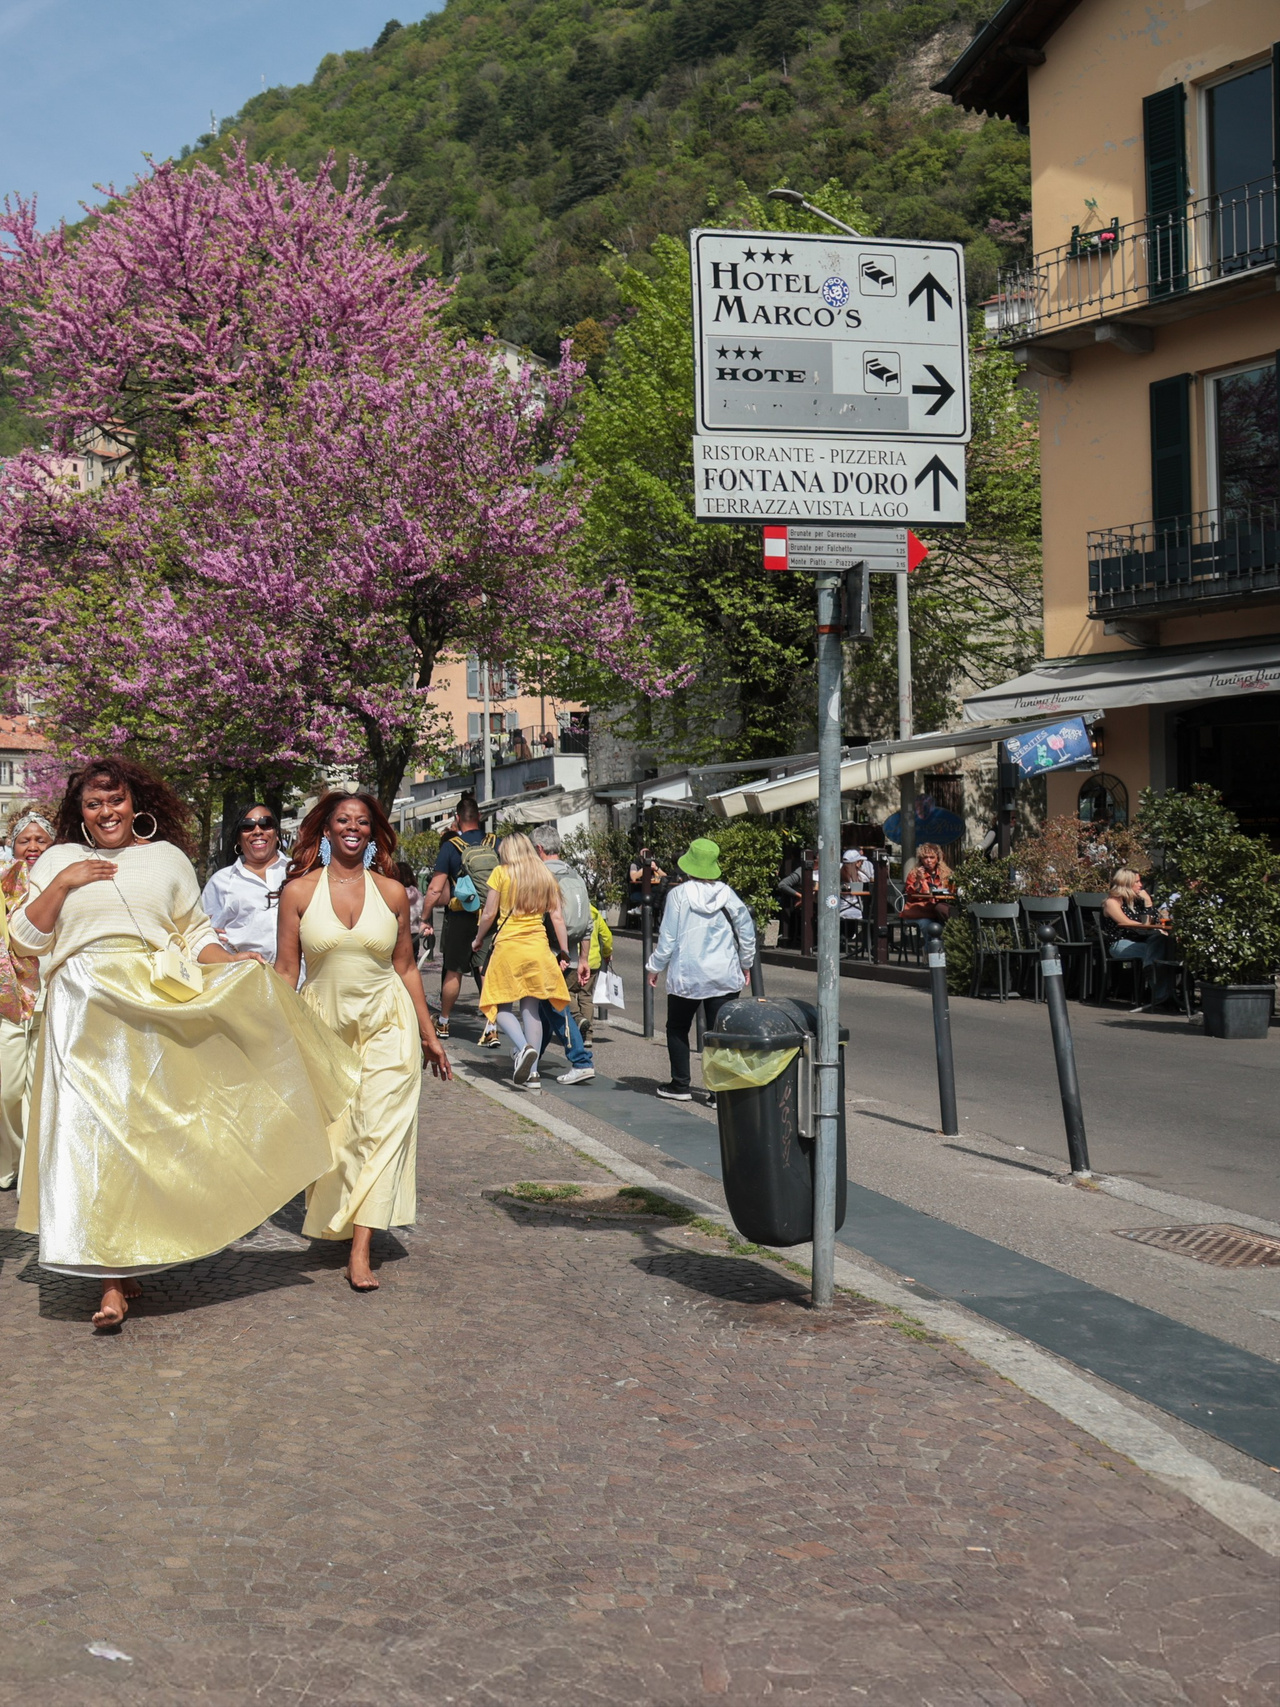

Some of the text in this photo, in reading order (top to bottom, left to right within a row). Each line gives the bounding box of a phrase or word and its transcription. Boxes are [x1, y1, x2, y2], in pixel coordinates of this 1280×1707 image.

[710, 262, 820, 294] HOTEL
[712, 294, 862, 329] MARCO'S
[715, 367, 806, 383] HOTE
[702, 445, 815, 463] RISTORANTE
[830, 449, 907, 466] PIZZERIA
[703, 468, 908, 496] FONTANA D'ORO
[703, 498, 909, 518] TERRAZZA VISTA LAGO
[790, 529, 812, 537] Brunate
[790, 543, 812, 551] Brunate
[1255, 668, 1280, 681] Buo
[1014, 697, 1050, 708] Panino
